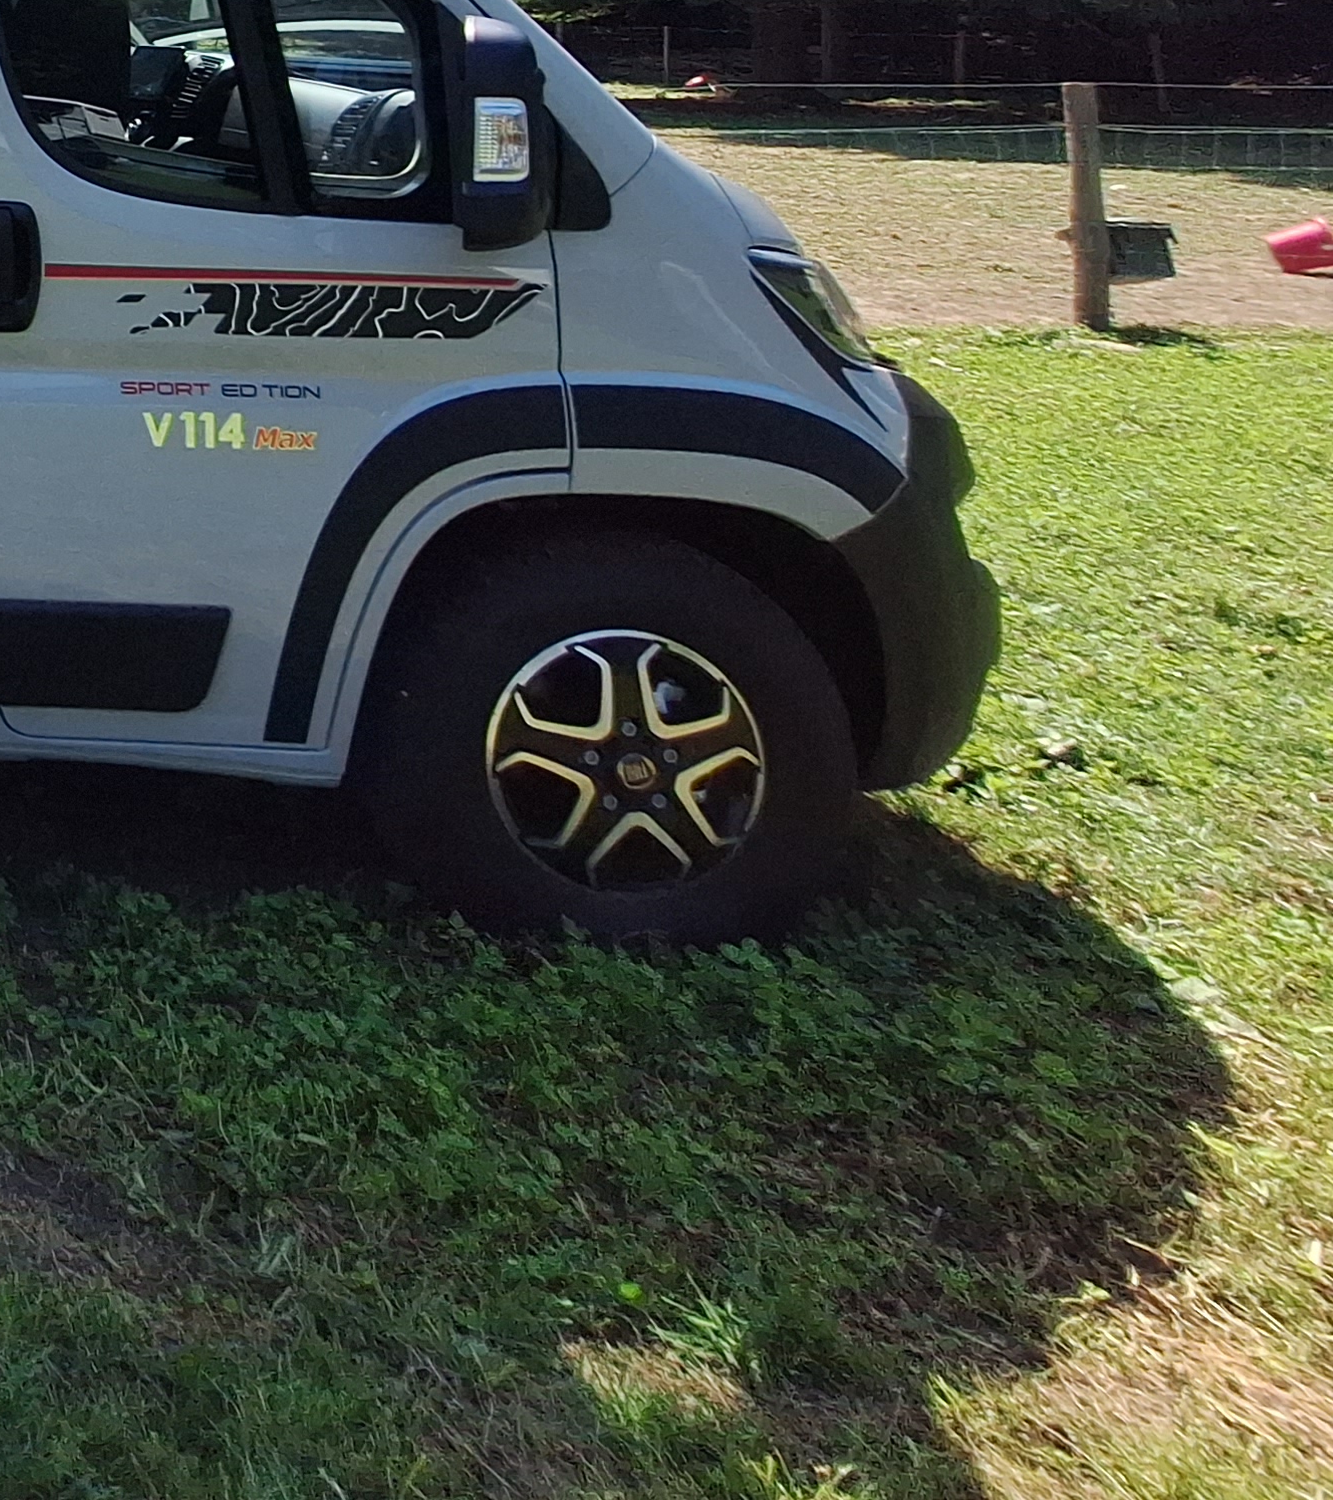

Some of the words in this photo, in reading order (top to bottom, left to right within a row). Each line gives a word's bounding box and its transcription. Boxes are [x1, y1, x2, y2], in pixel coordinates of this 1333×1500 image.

[119, 380, 211, 397] SPORT
[220, 383, 322, 400] EDTION
[141, 411, 247, 450] V114
[252, 425, 319, 451] Max
